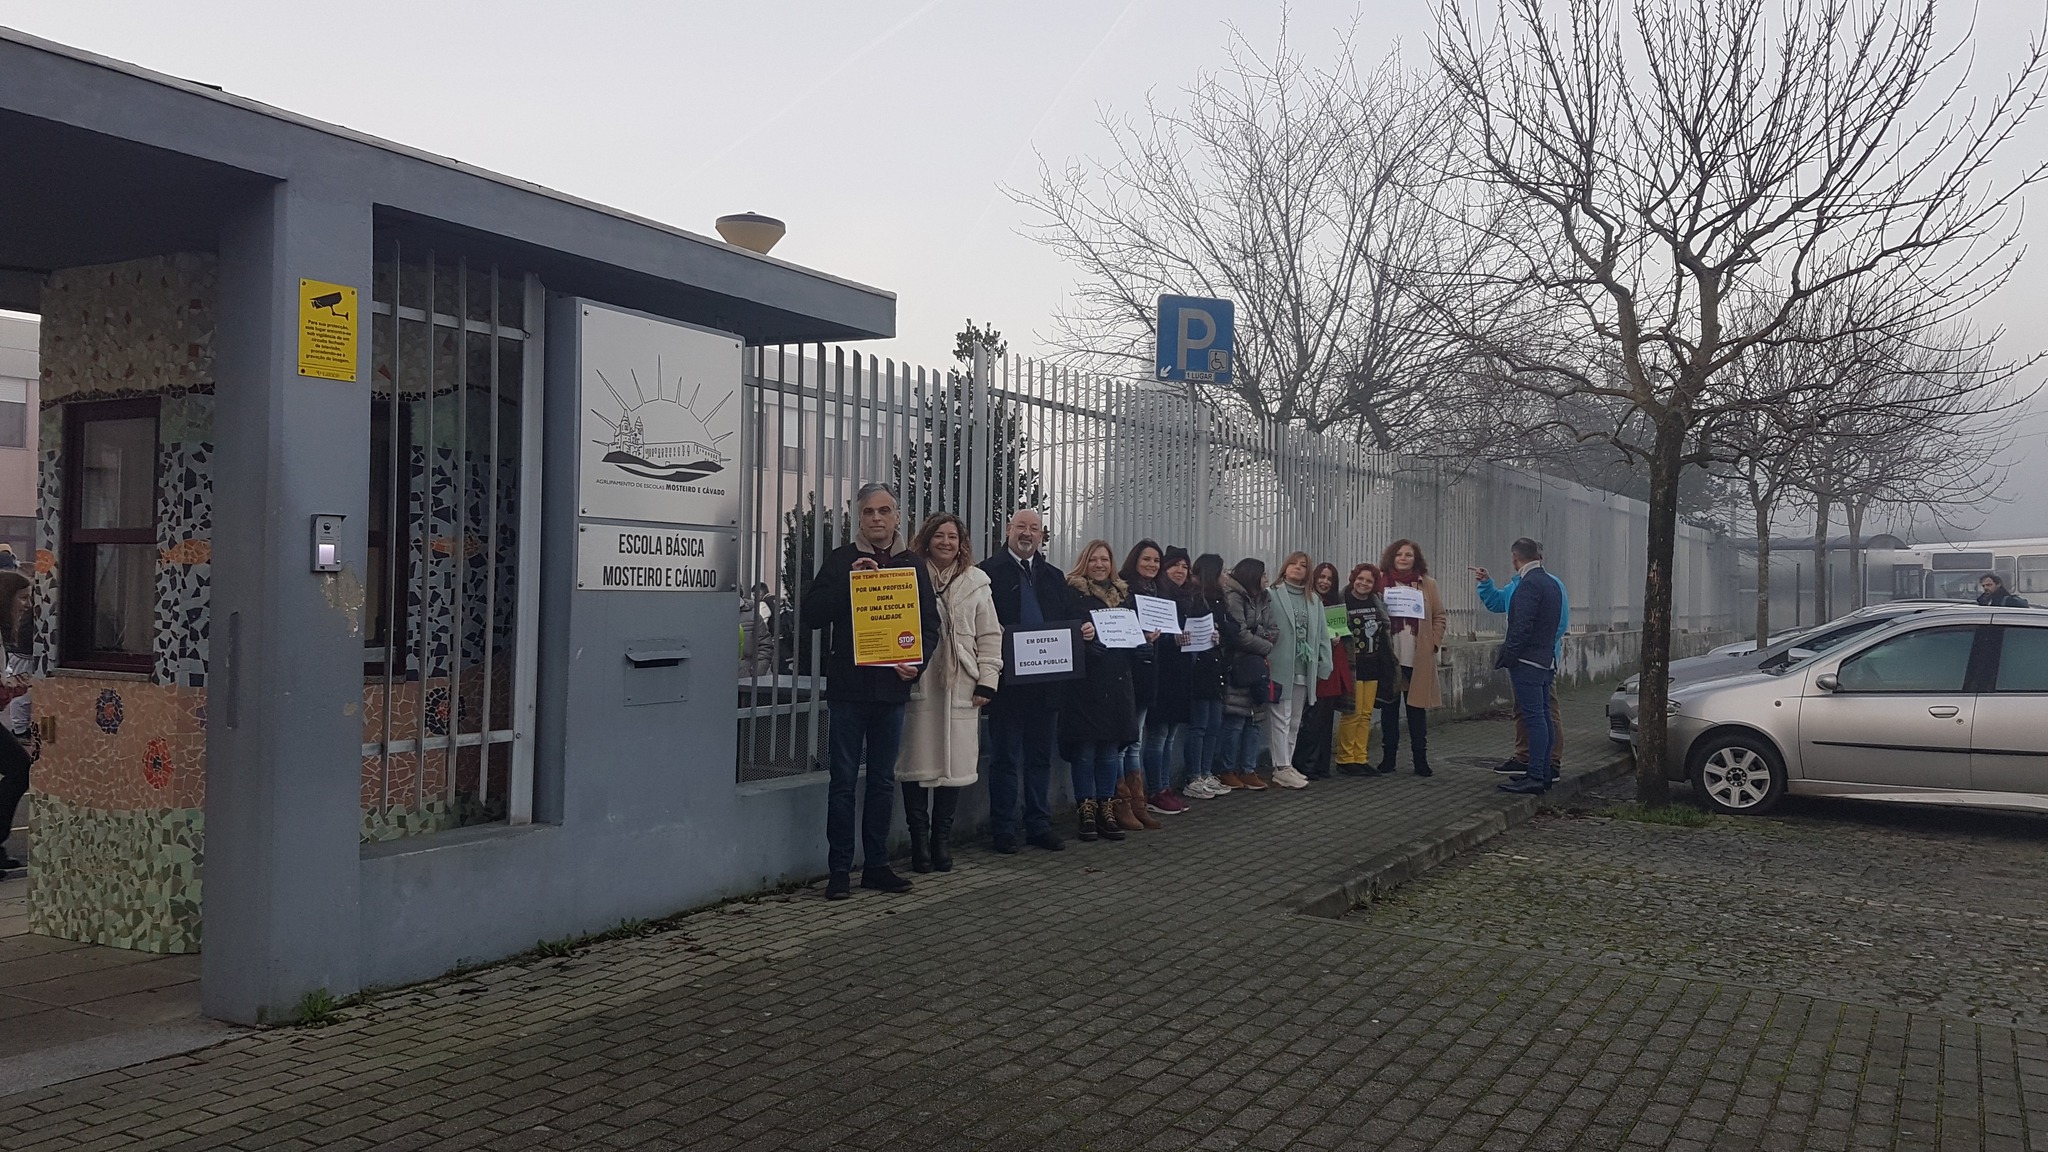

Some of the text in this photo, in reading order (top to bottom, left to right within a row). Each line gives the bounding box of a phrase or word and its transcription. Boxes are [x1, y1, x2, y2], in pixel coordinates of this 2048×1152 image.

[1177, 307, 1217, 370] P
[1192, 372, 1213, 380] LUGAR
[596, 478, 635, 487] AGRUPAMENTO
[666, 484, 696, 493] MOSTEIRO
[702, 486, 725, 496] CÁVADO
[618, 533, 705, 557] ESCOLA BÁSICA
[602, 565, 716, 588] MOSTEIRO E CÁVADO
[883, 582, 913, 591] PROFISSÃO
[1327, 616, 1346, 627] SPEITO
